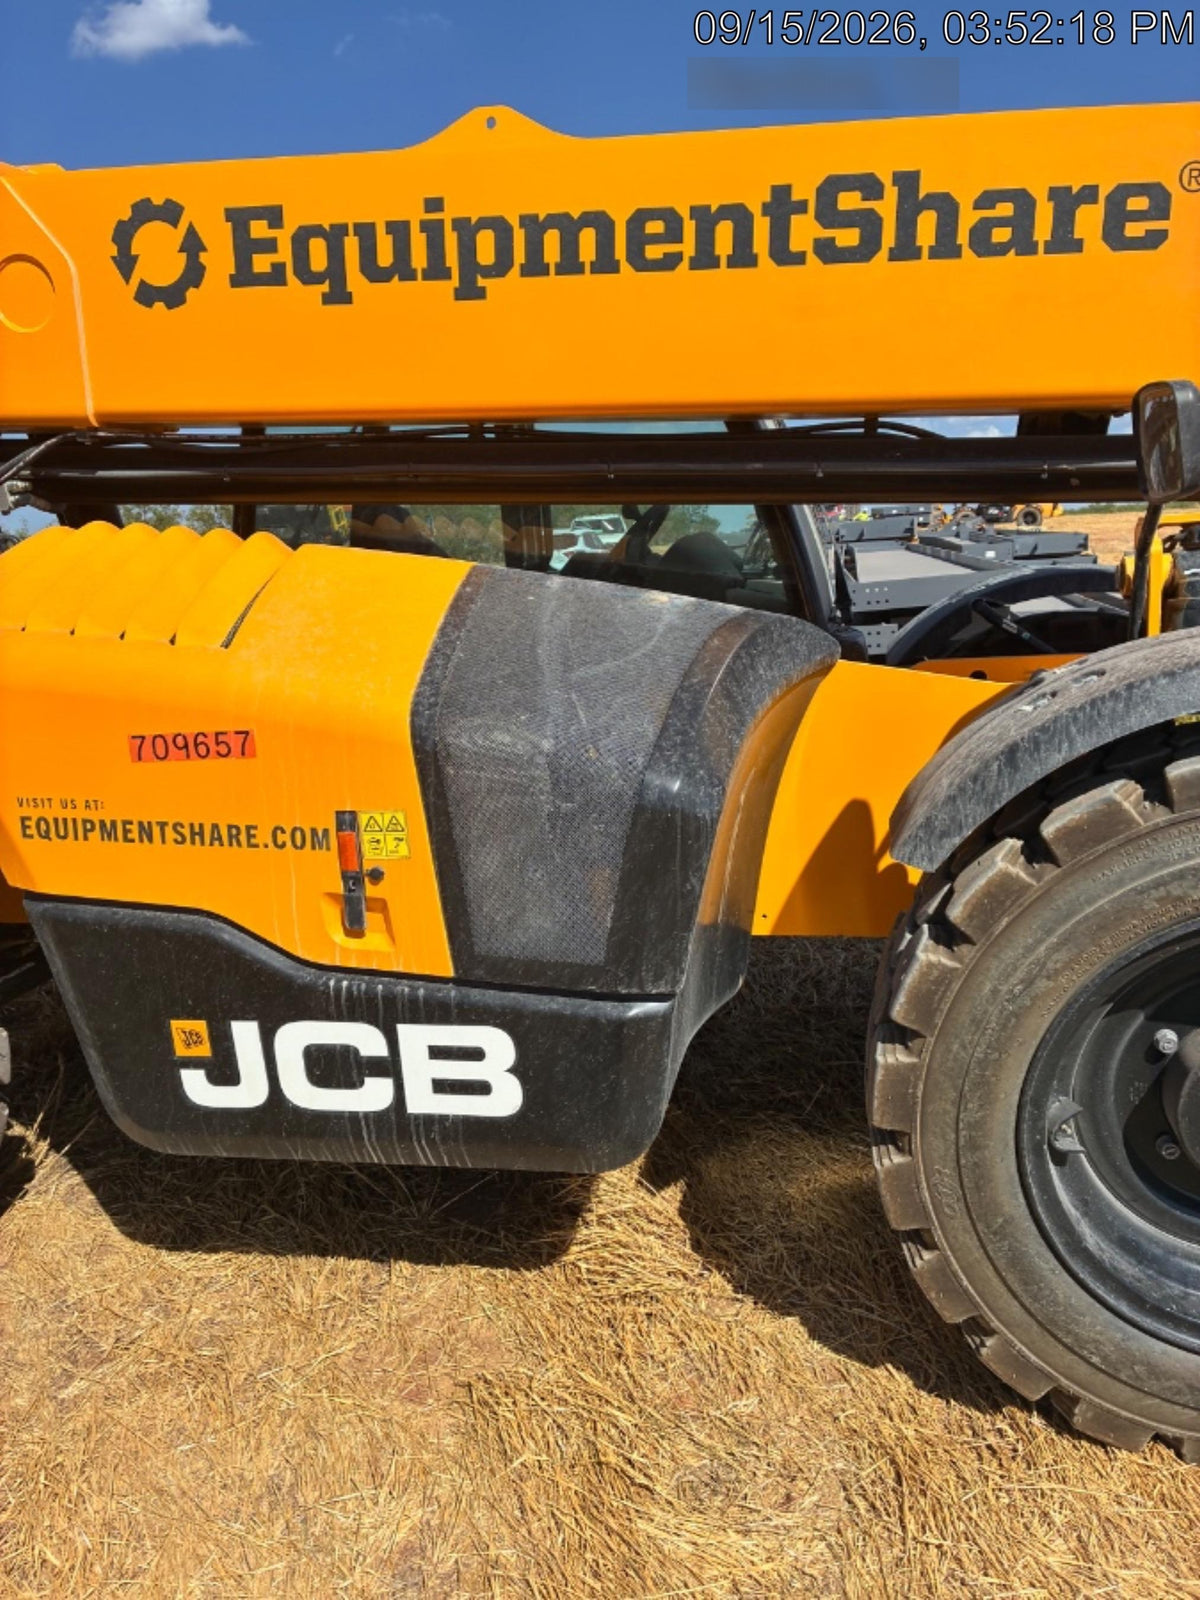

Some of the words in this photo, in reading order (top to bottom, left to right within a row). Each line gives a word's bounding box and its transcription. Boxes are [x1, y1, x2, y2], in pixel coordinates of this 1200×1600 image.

[224, 170, 1172, 306] EquipmentShare
[131, 730, 250, 761] 709657
[17, 797, 53, 809] VISIT
[60, 797, 77, 810] US
[84, 799, 105, 811] AT:
[20, 815, 331, 852] EQUIPMENTSHARE.COM
[176, 1020, 523, 1117] JCB
